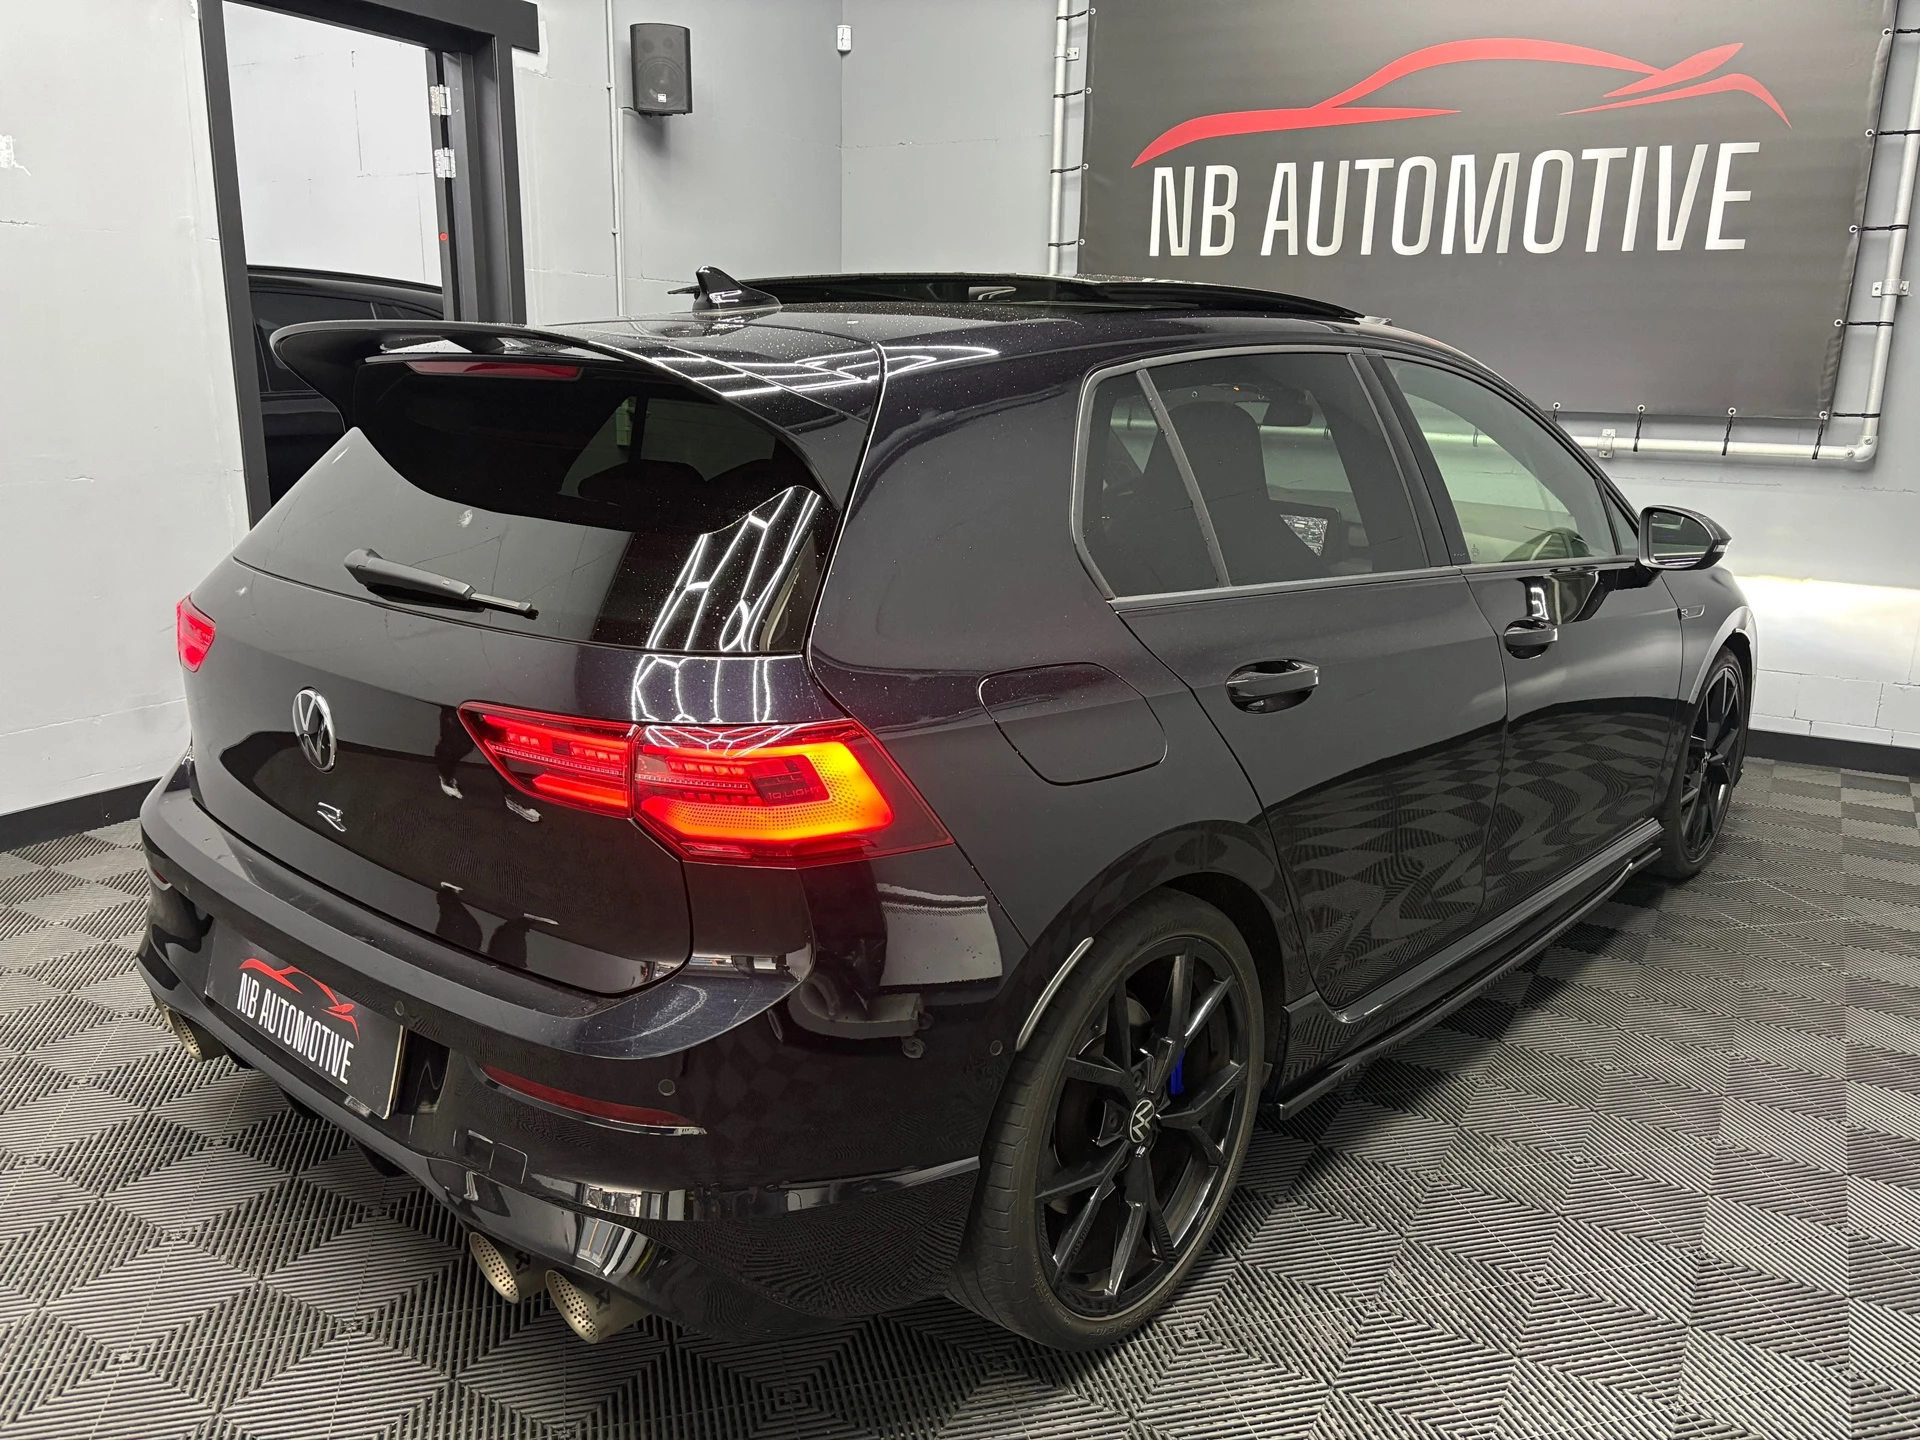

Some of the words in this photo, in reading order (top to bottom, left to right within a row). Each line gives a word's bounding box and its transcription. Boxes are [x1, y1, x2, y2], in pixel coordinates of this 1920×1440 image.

[1149, 164, 1239, 257] NB
[1260, 142, 1760, 255] AUTOMOTIVE
[236, 972, 260, 1019] NB
[258, 988, 355, 1085] AUTOMOTIVE
